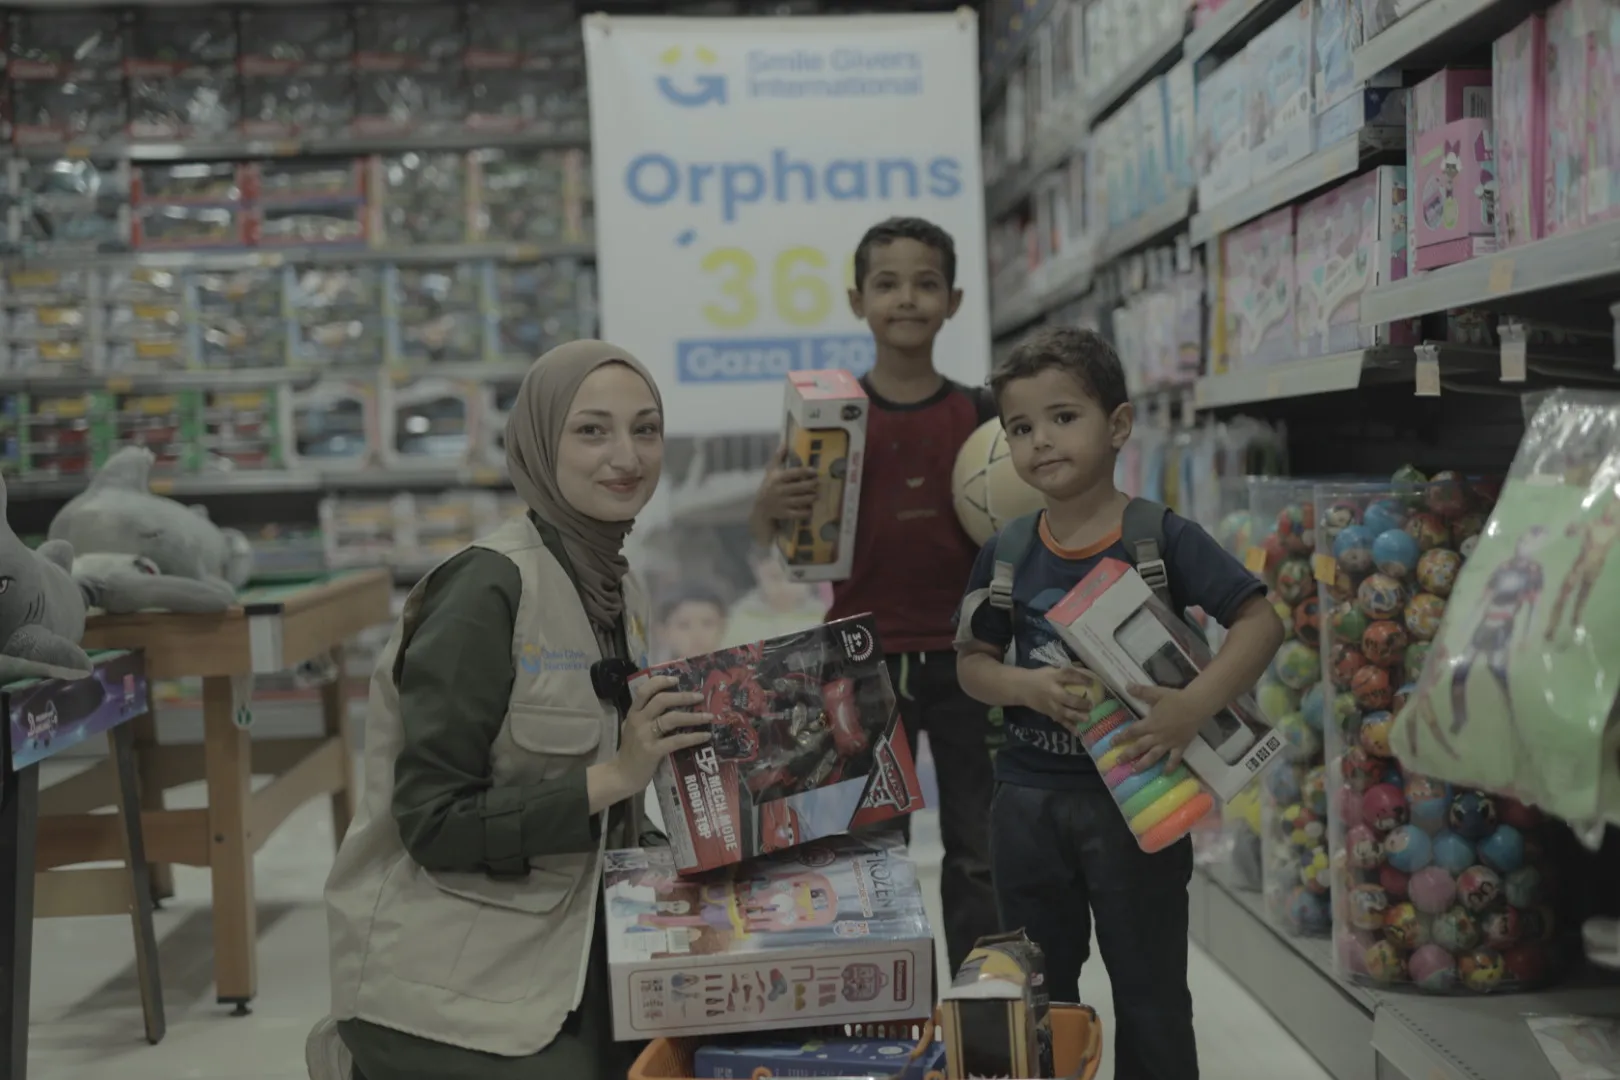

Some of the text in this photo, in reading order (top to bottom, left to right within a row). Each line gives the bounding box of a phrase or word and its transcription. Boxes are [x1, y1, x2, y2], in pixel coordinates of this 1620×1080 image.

[624, 148, 963, 223] Orphans
[700, 245, 857, 329] 36
[686, 345, 792, 378] Gaza
[821, 337, 877, 373] 20
[684, 774, 705, 813] ROBOT
[708, 775, 729, 813] MECH
[719, 813, 738, 852] MODE
[866, 848, 895, 908] FROZEN
